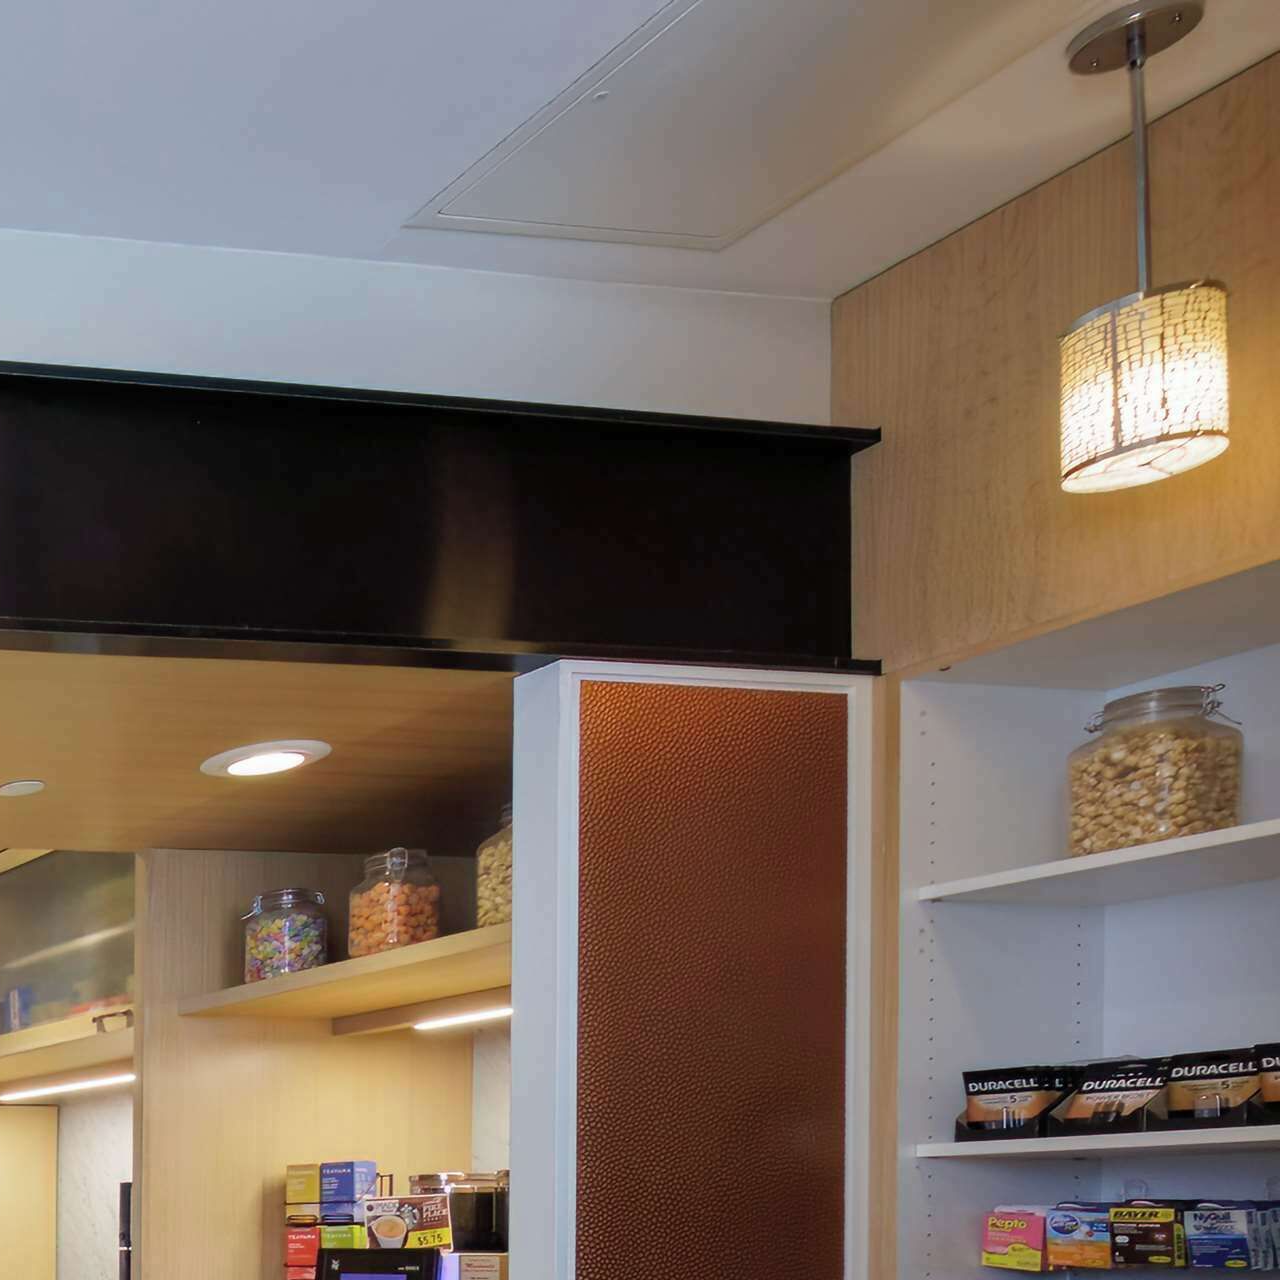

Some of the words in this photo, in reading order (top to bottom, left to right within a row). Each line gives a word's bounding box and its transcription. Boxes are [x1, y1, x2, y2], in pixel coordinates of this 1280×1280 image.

[1171, 1060, 1258, 1078] DURACELL
[968, 1078, 1038, 1092] DURACELL
[1082, 1076, 1166, 1090] DURACELL
[1113, 1210, 1160, 1219] BAYER
[988, 1217, 1027, 1229] Pepto
